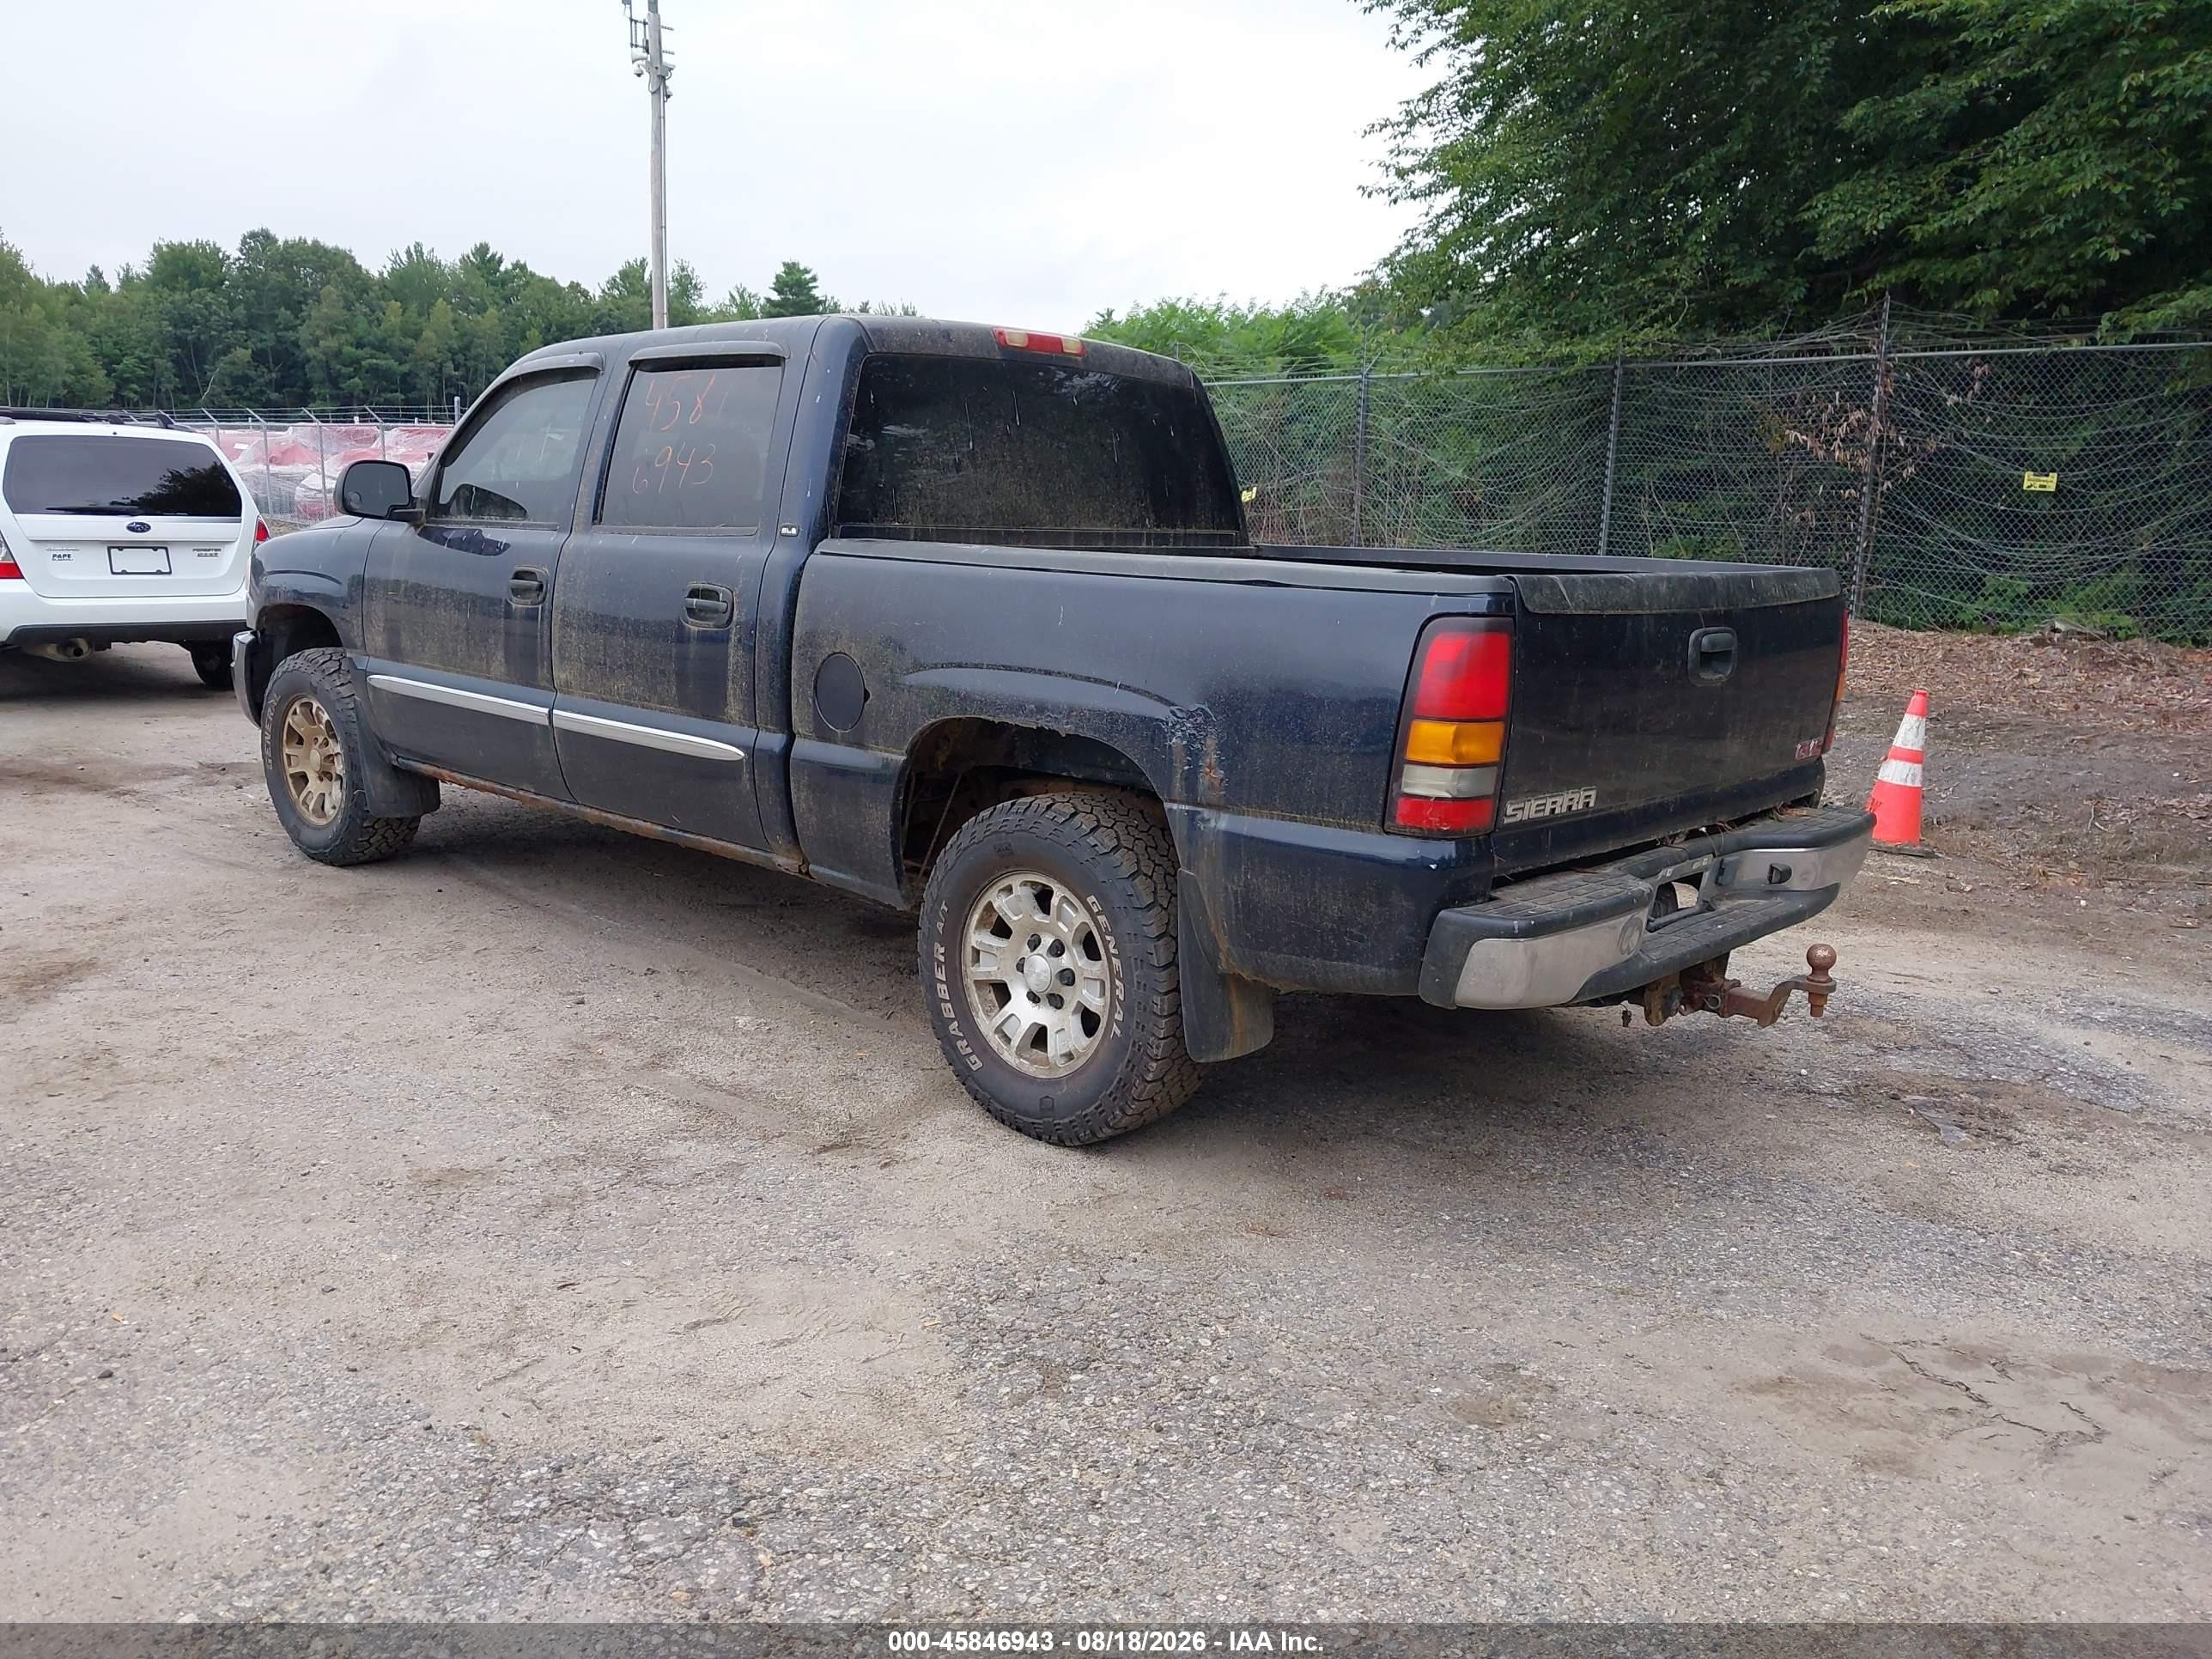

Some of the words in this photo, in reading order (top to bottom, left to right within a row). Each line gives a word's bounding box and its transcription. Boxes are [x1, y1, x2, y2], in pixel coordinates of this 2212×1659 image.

[633, 441, 716, 495] 6943
[1504, 786, 1597, 824] SIERRA
[933, 941, 984, 1072] GRABBER
[1086, 895, 1125, 1042] GENERAL
